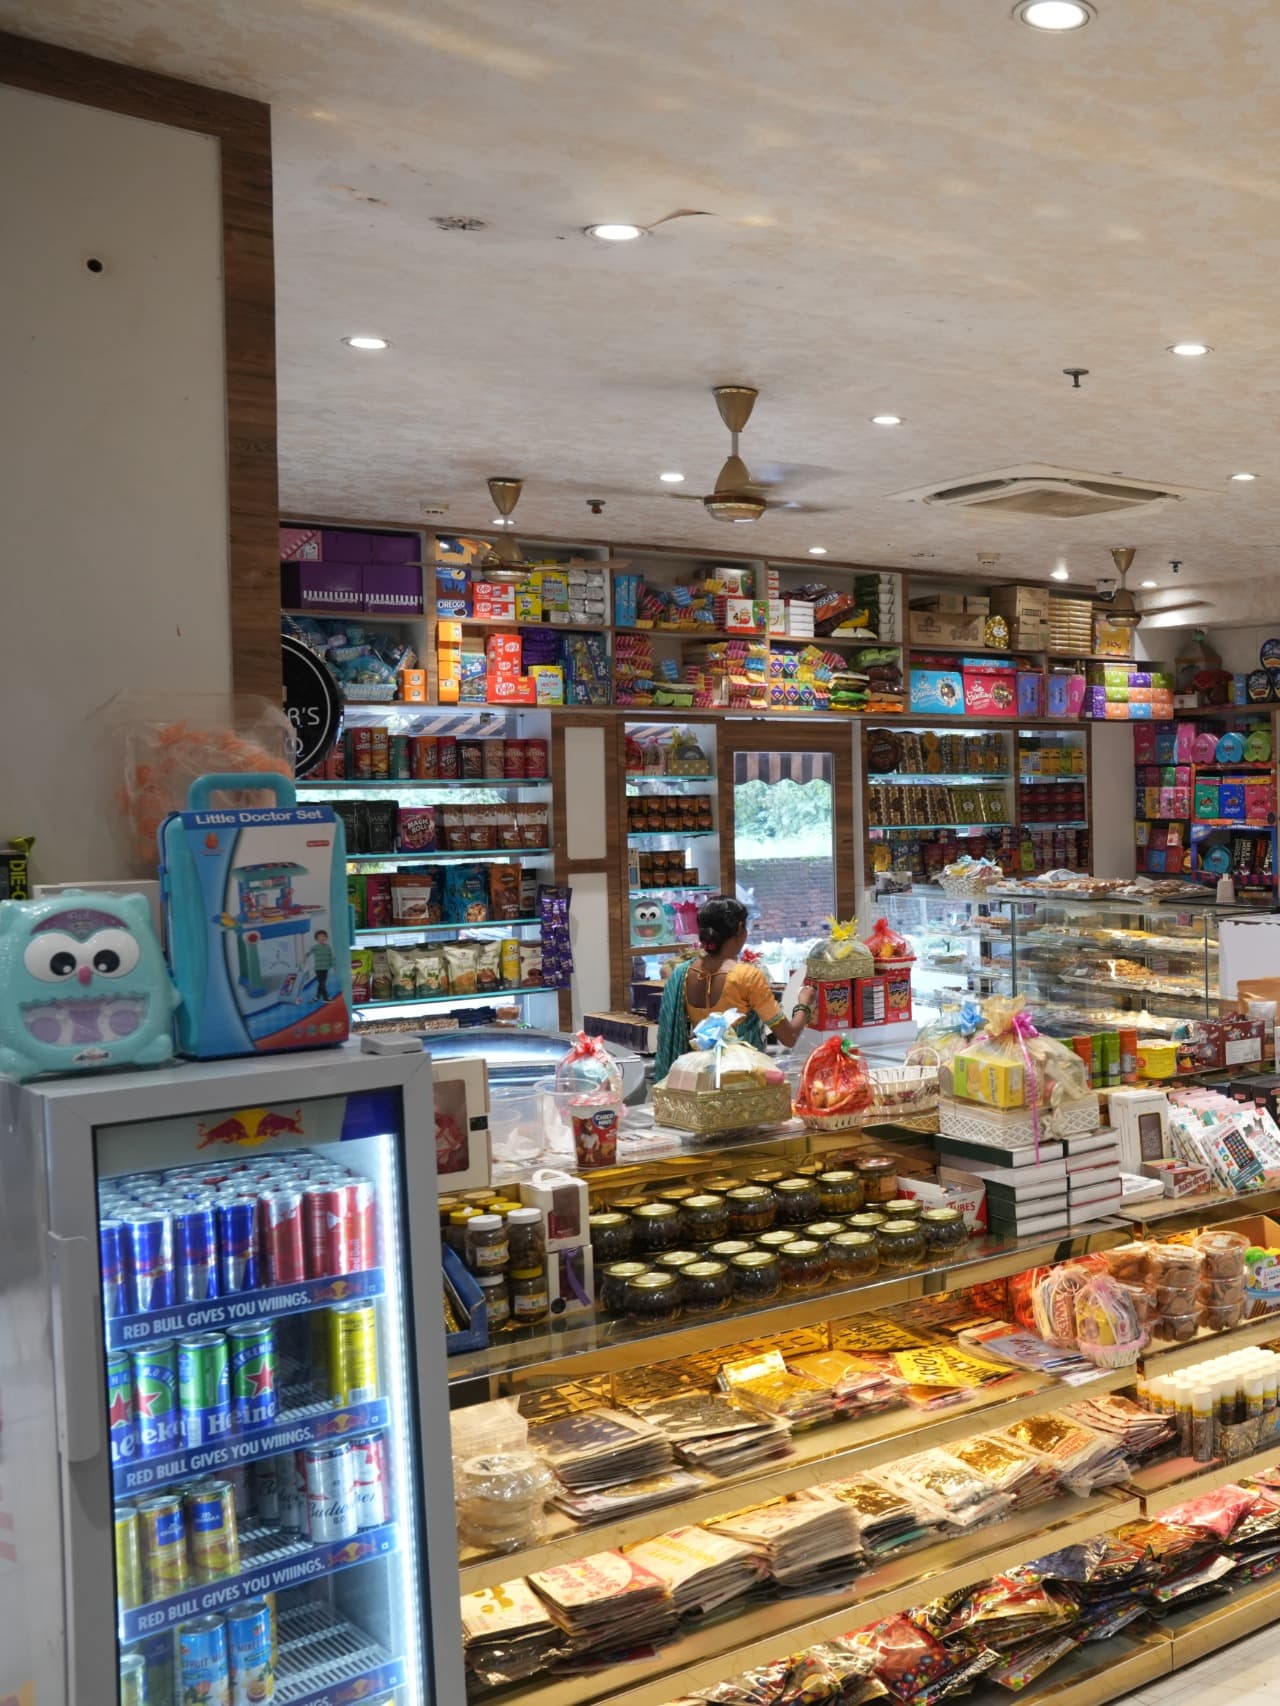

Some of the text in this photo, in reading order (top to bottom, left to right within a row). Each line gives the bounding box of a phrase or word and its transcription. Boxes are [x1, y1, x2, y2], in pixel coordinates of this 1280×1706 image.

[286, 706, 320, 725] R'S
[195, 808, 324, 825] Little Doctor Set
[123, 1320, 150, 1340] RED
[153, 1313, 185, 1334] BULL
[187, 1307, 225, 1328] GIVES
[227, 1301, 256, 1319] YOU
[126, 1467, 153, 1488] RED
[156, 1461, 187, 1482] BULL
[190, 1450, 229, 1470] GIVES
[231, 1440, 260, 1458] YOU
[138, 1610, 164, 1631] RED
[168, 1599, 200, 1622] BULL
[202, 1585, 240, 1608] GIVES
[242, 1574, 271, 1593] YOU
